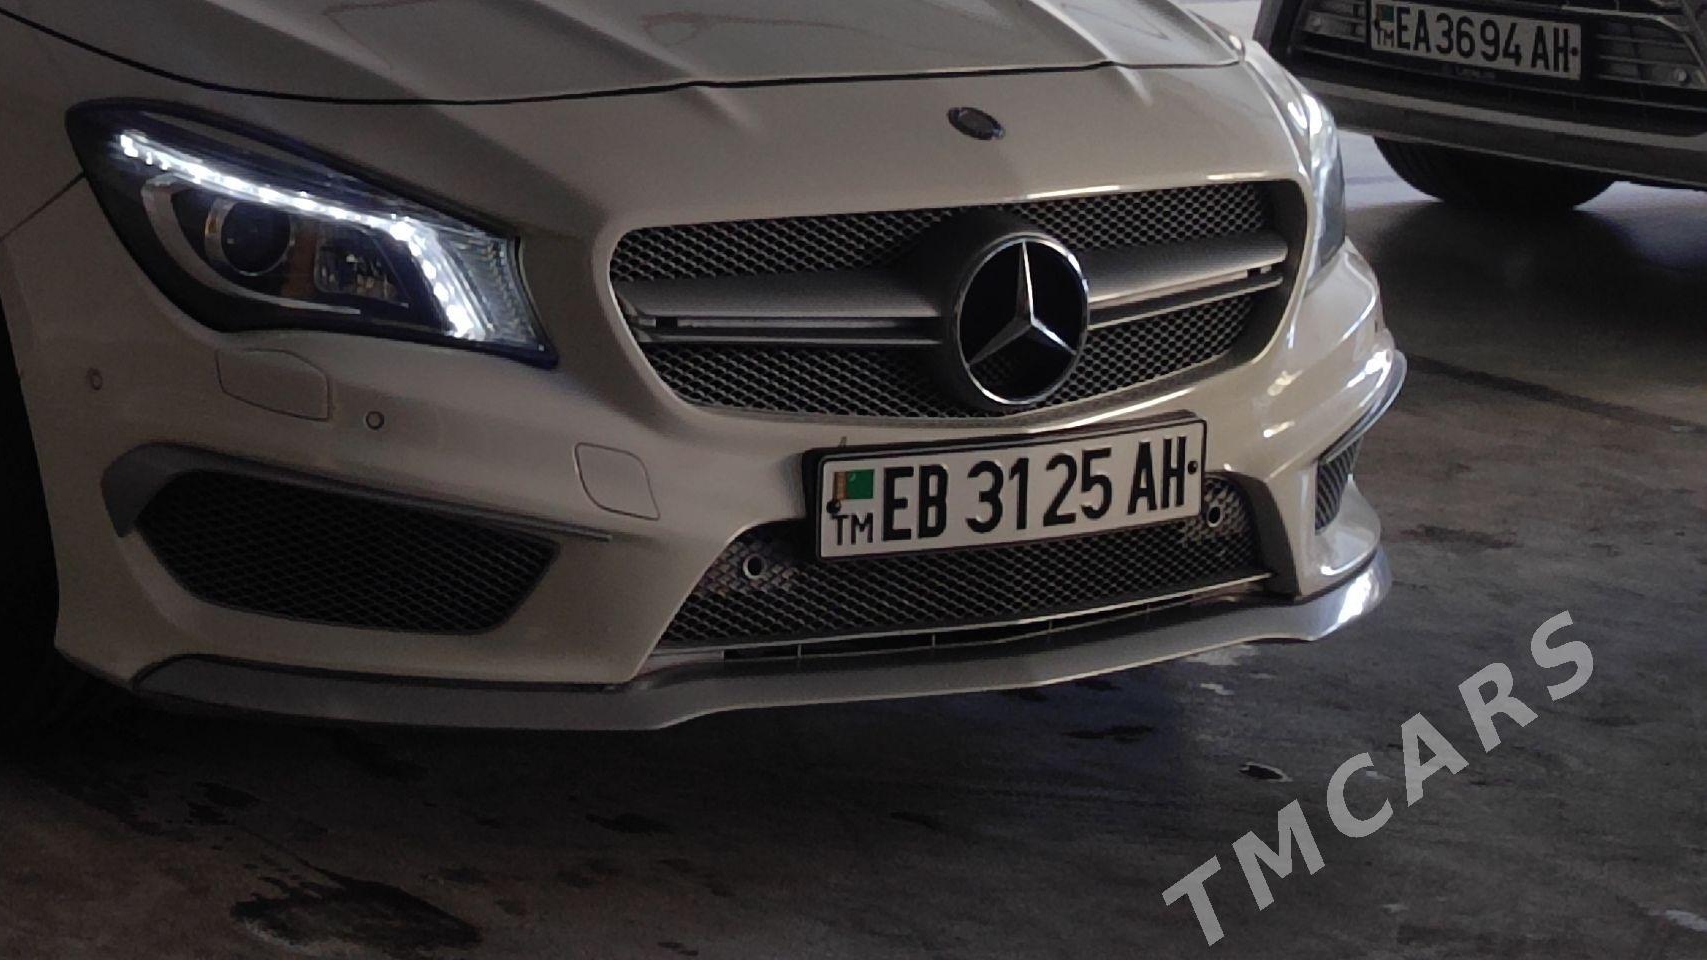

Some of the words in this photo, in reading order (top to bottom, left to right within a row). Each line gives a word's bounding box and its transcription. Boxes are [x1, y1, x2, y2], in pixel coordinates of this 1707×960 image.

[1531, 25, 1570, 73] AH
[883, 464, 949, 541] EB
[1127, 436, 1187, 515] AH
[829, 511, 874, 545] TM
